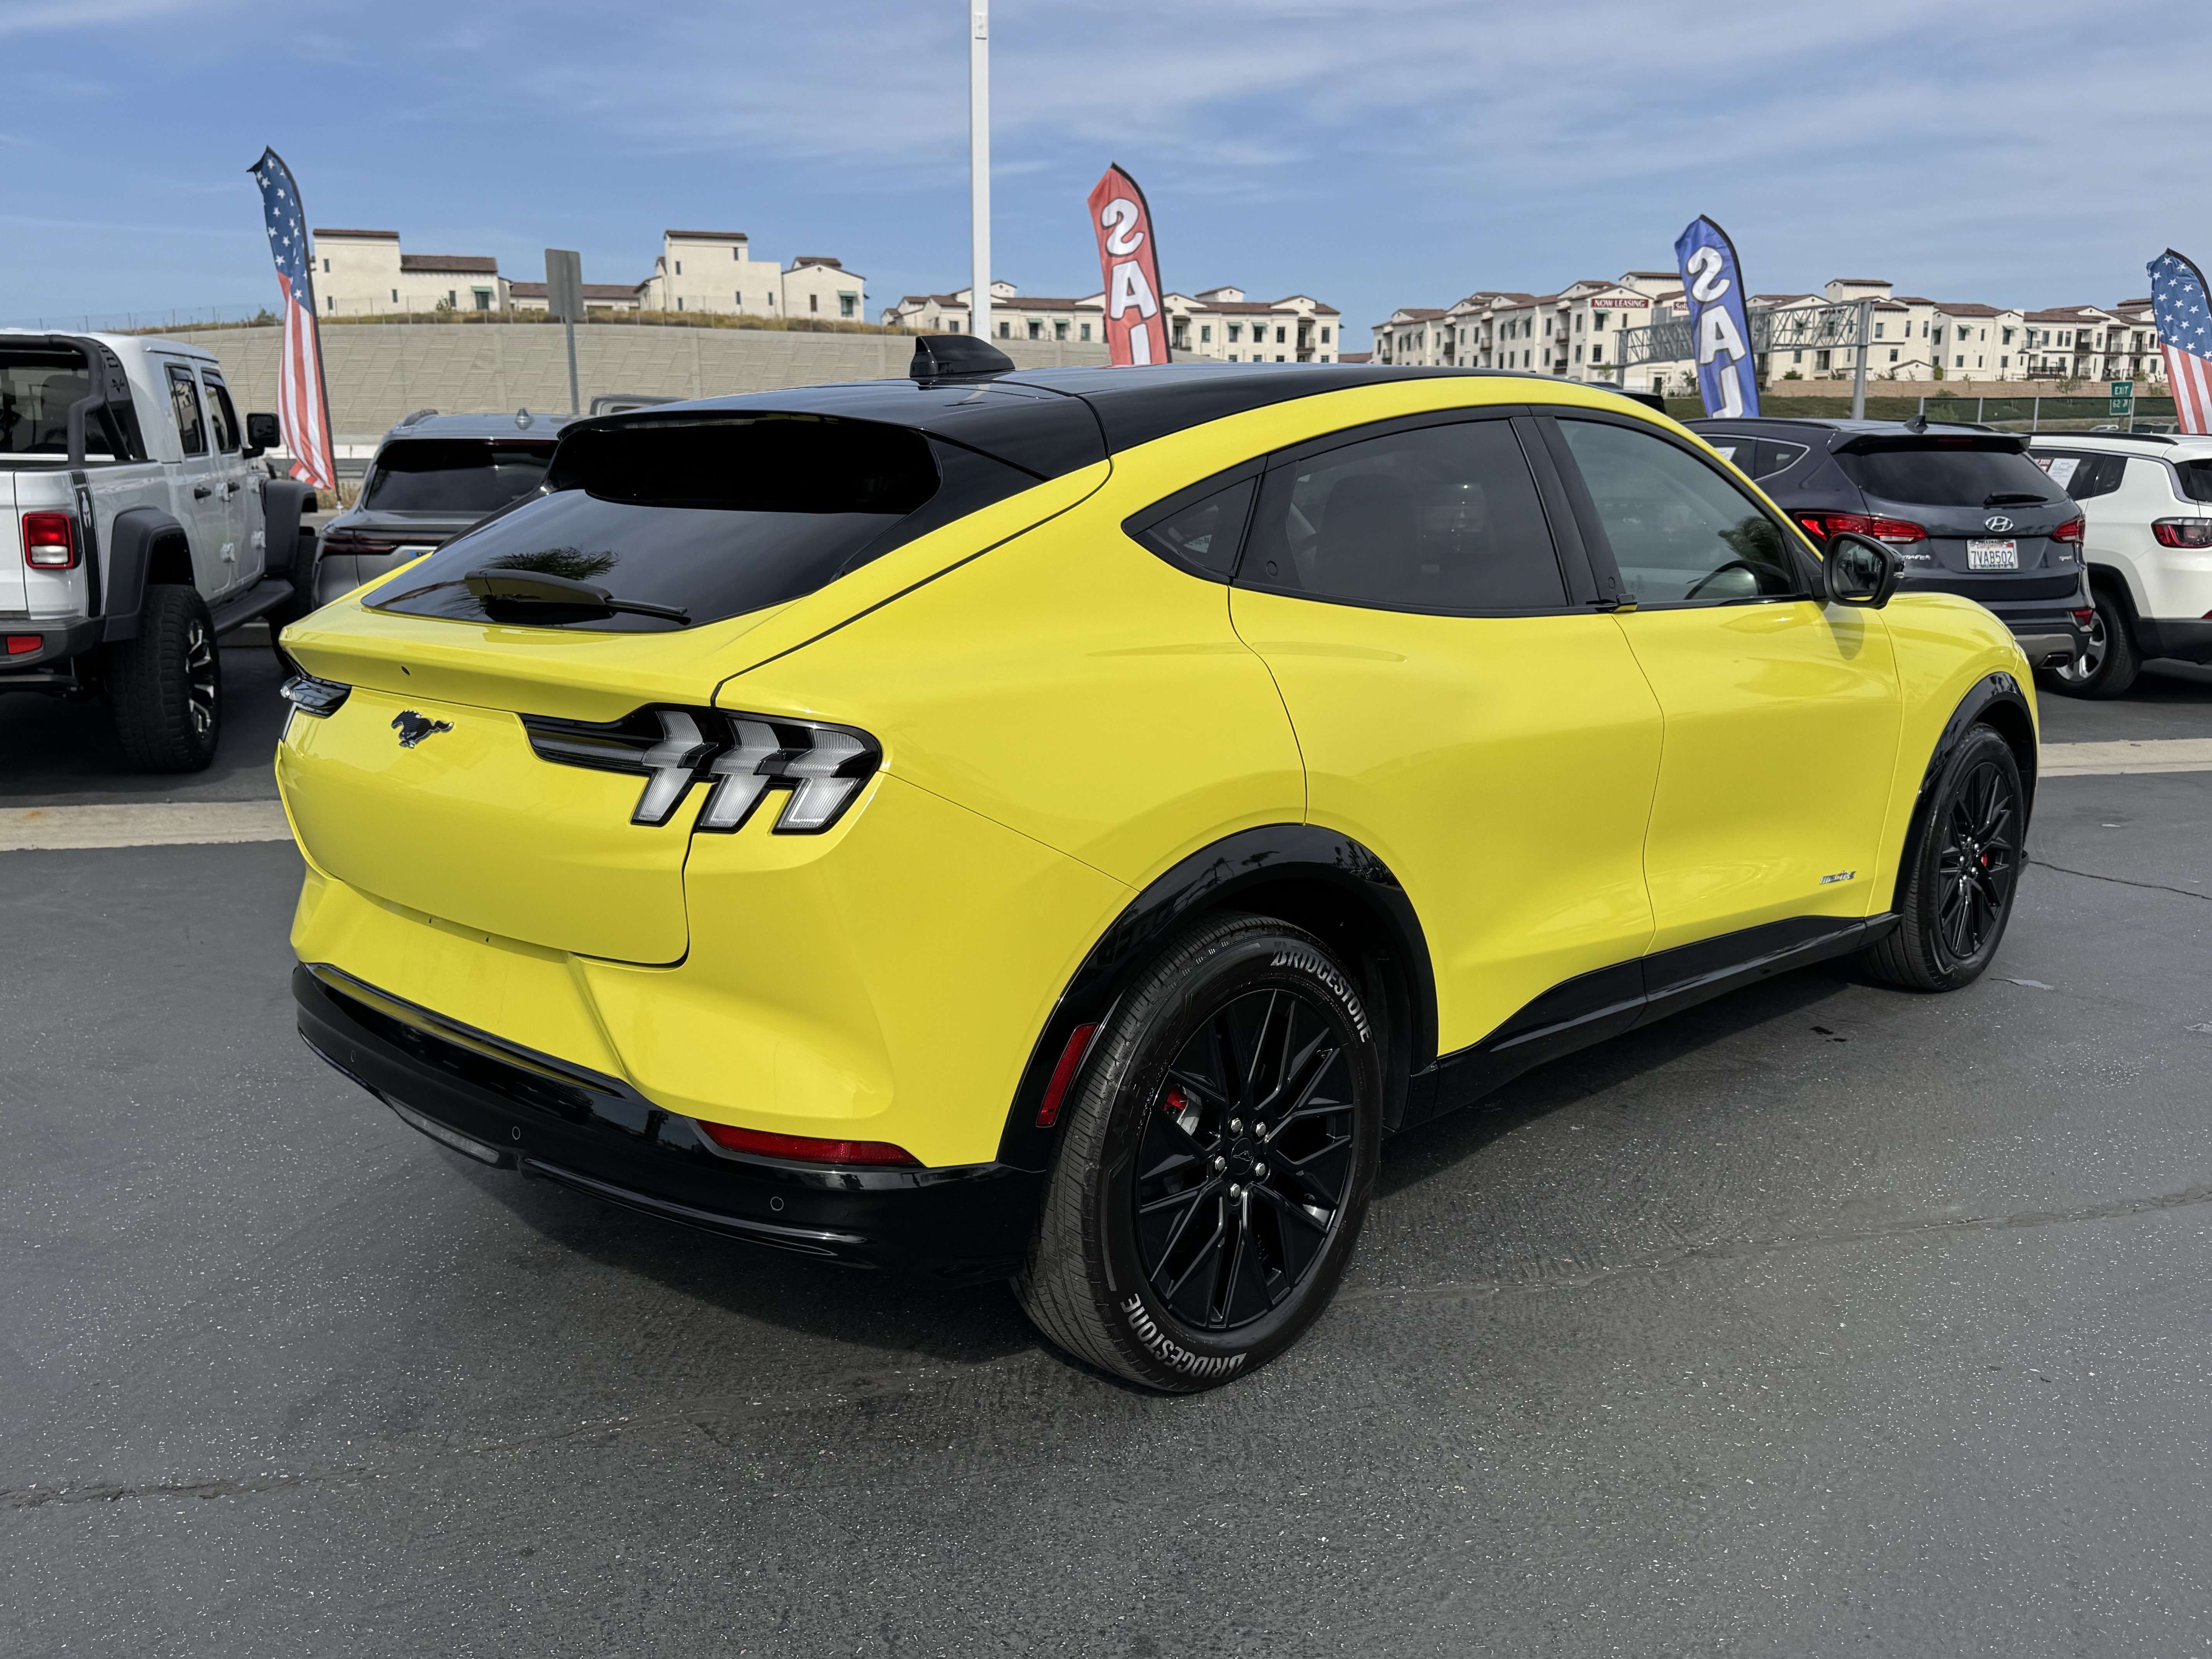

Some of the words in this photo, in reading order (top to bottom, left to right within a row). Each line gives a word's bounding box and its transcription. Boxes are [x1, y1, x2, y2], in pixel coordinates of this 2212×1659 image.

[2114, 386, 2129, 395] EXIT
[2112, 399, 2121, 408] 62
[1971, 551, 2013, 563] 7VAB502
[1270, 941, 1372, 1043] BRIDGESTONE
[1120, 1293, 1247, 1378] BRIDGESTONE
